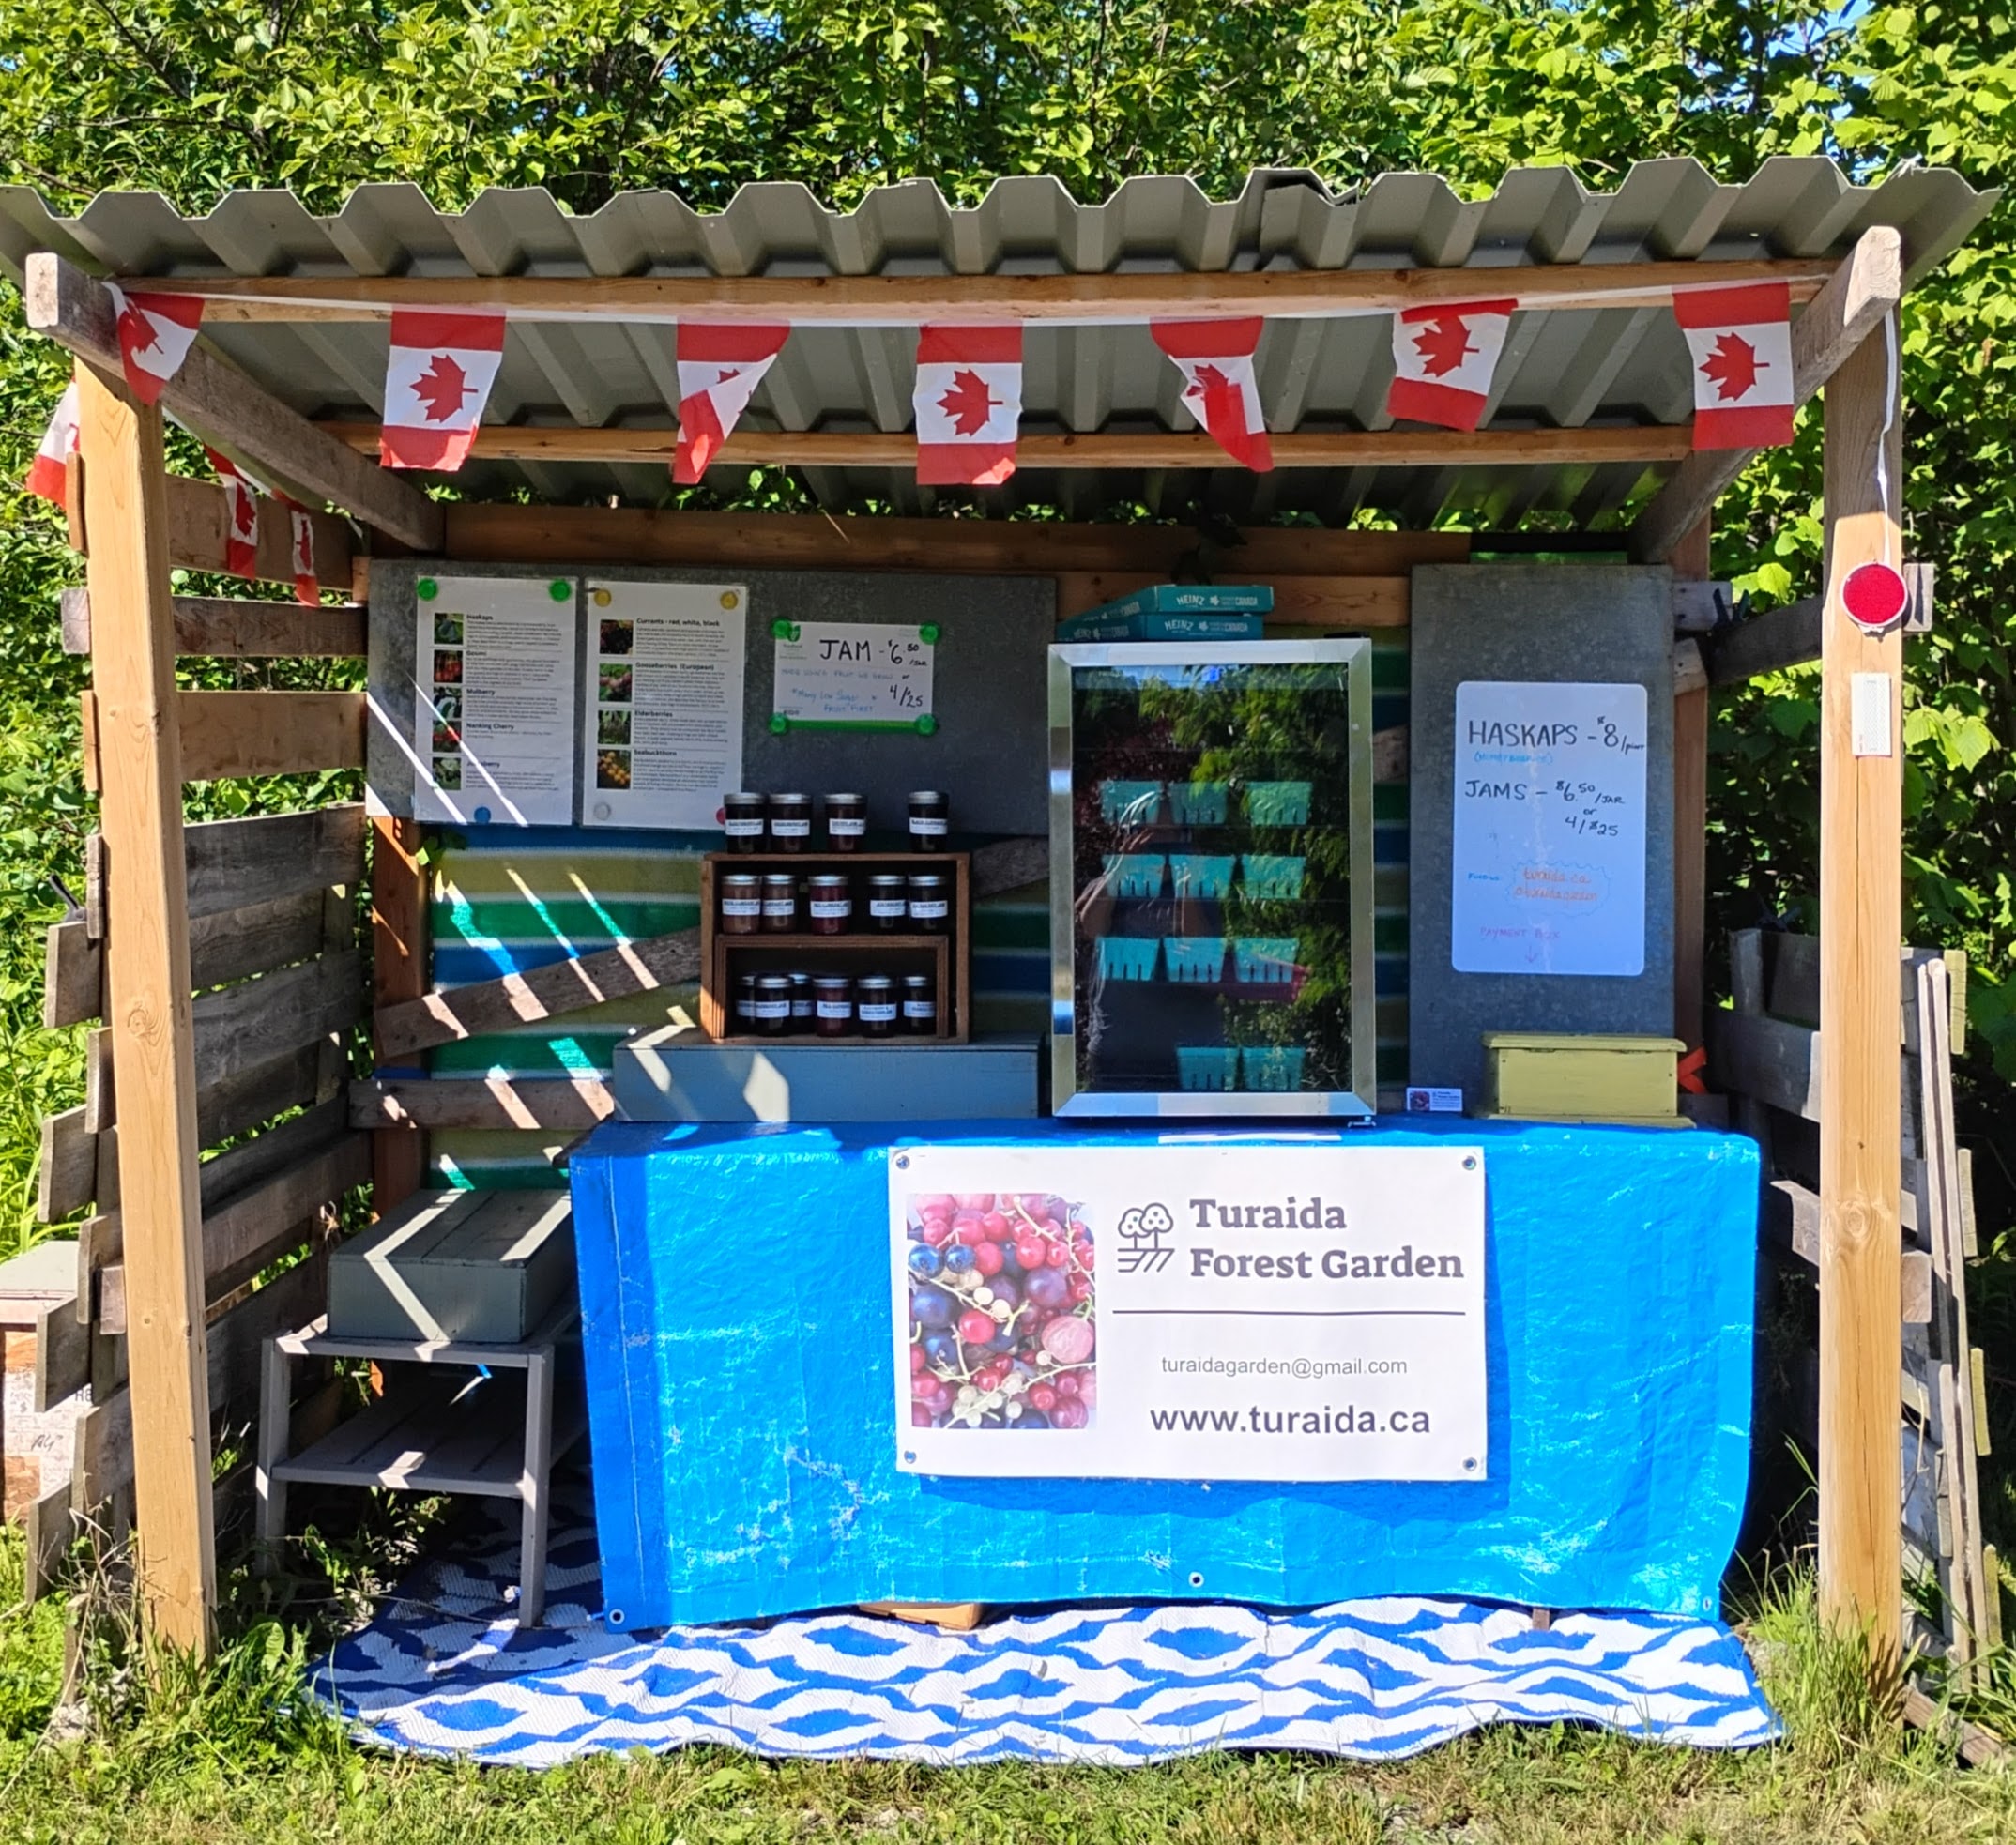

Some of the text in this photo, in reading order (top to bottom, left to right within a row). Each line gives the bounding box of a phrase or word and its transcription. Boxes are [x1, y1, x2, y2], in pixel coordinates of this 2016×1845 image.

[1176, 595, 1205, 606] HEINZ
[819, 639, 871, 662] JAM
[1468, 720, 1579, 748] HASKAPS
[1465, 780, 1527, 801] JAMS
[1189, 1196, 1347, 1229] Turaida
[1190, 1246, 1464, 1279] Forest Garden
[1161, 1356, 1408, 1379] turaidagarden@gmail.com
[1150, 1406, 1430, 1434] www.turaida.ca
